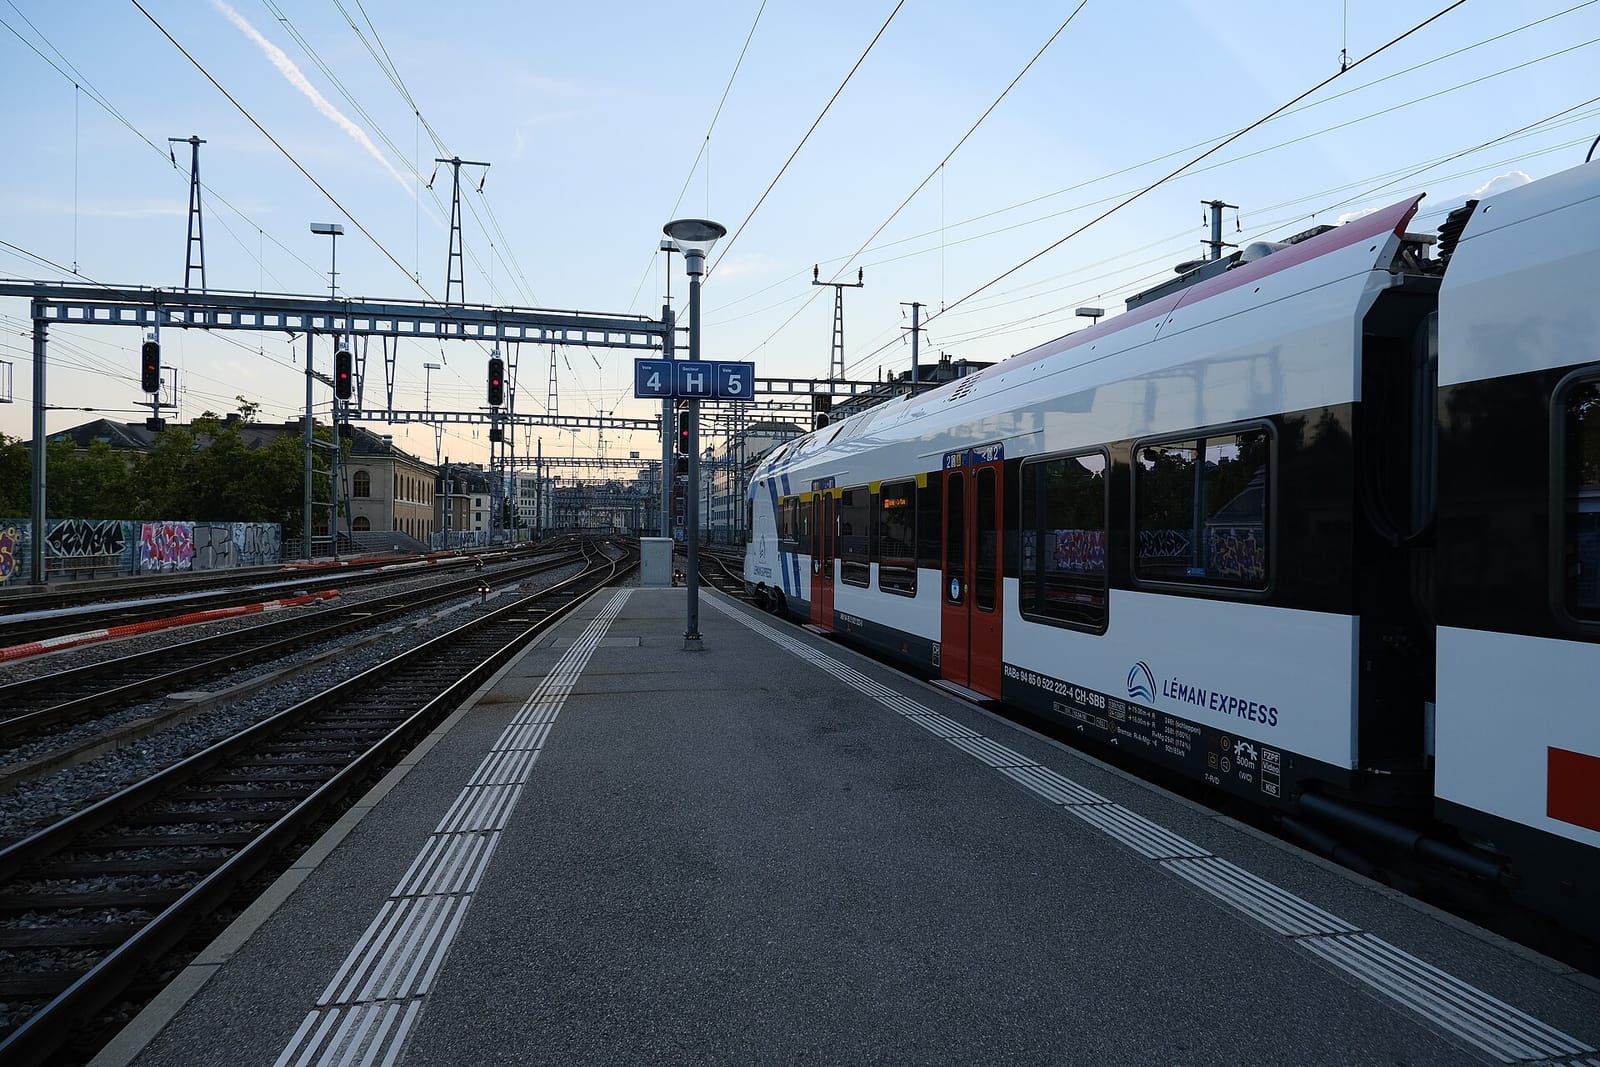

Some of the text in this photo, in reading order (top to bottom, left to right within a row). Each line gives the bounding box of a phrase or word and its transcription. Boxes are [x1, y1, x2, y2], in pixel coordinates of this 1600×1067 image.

[646, 372, 661, 391] 4
[686, 373, 703, 392] H
[727, 374, 742, 394] 5
[946, 456, 951, 468] 2
[993, 446, 998, 460] 2
[836, 515, 840, 536] 1
[1004, 665, 1105, 709] RABe 94 85 0 522 222-4 CH-SBB
[1163, 677, 1278, 727] LÉMAN EXPRESS
[1236, 755, 1255, 769] 500m
[1263, 751, 1279, 762] FZPF
[1265, 783, 1277, 794] KIS
